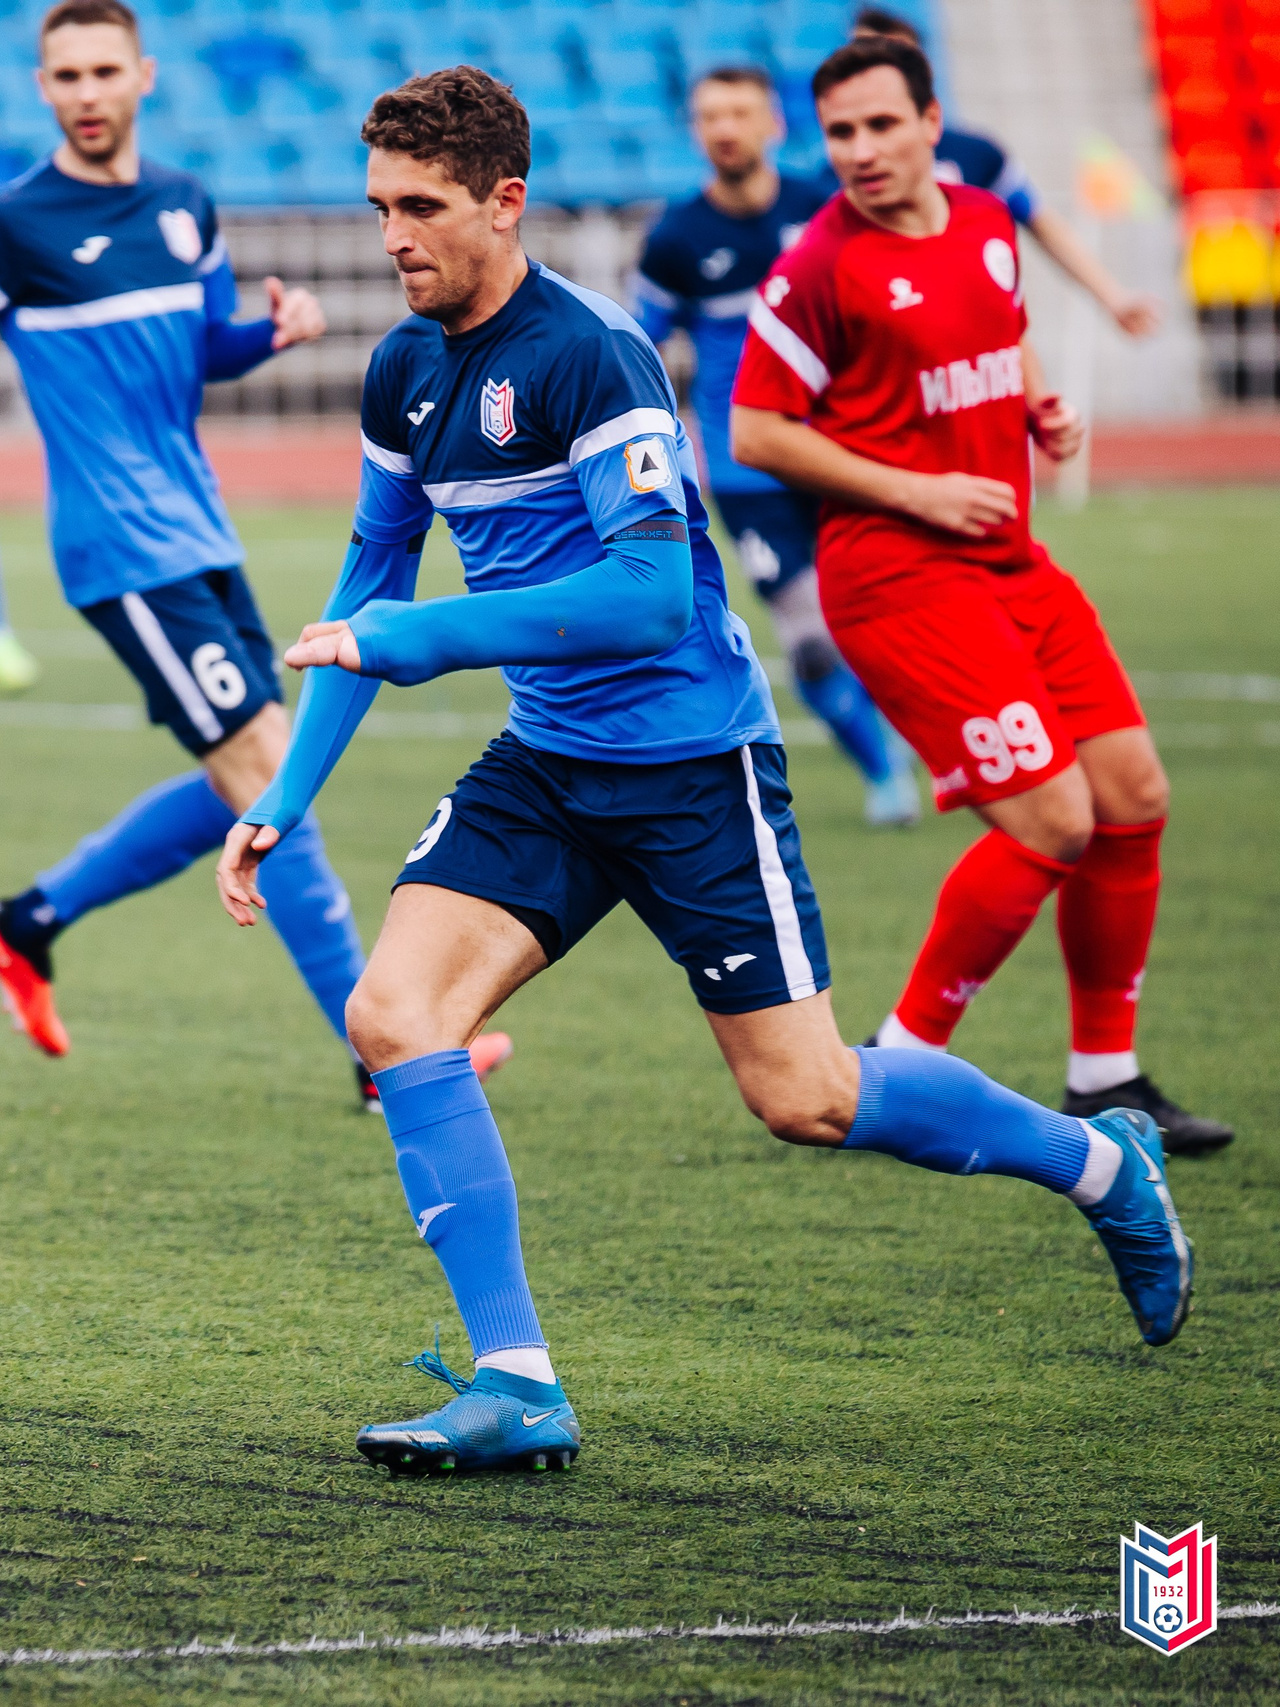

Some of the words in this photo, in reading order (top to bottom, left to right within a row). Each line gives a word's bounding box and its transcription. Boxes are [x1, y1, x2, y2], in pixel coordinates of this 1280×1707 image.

[919, 345, 1024, 415] ИЛЬПА
[191, 642, 247, 710] 6
[962, 700, 1053, 784] 99
